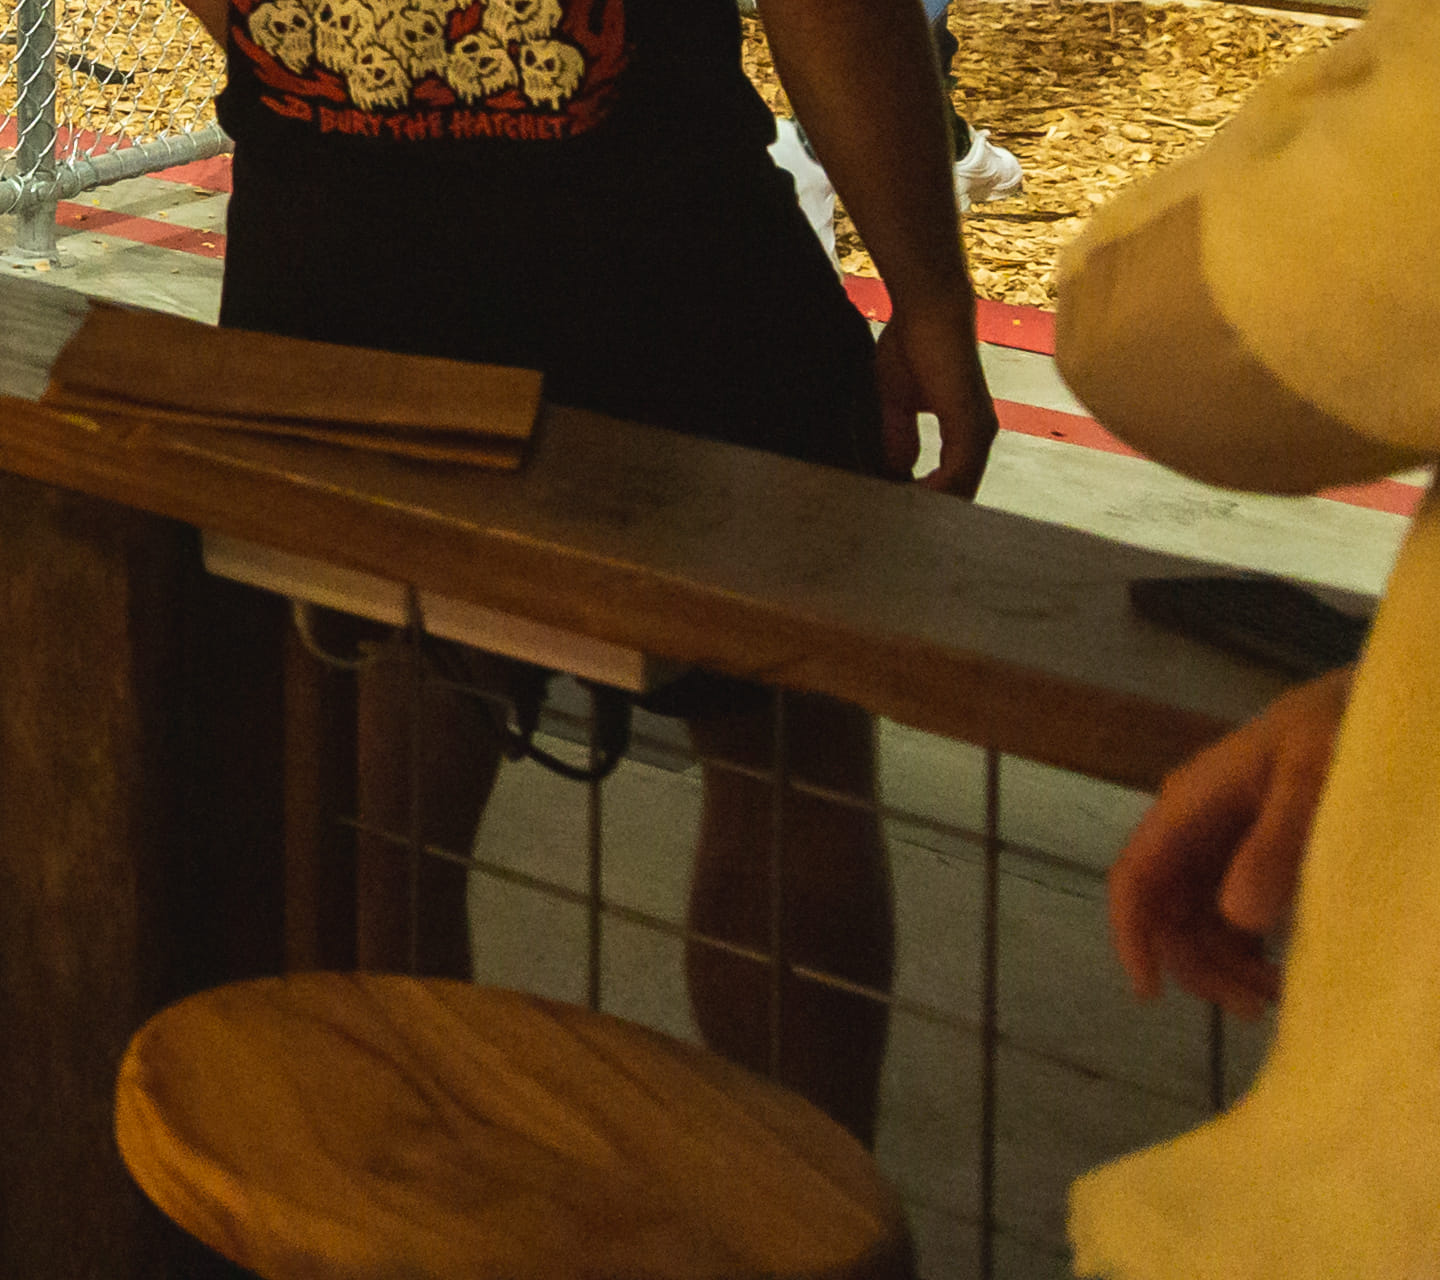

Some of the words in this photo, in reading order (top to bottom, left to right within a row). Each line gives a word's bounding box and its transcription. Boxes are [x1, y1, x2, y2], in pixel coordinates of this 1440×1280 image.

[318, 106, 382, 137] BURY
[385, 110, 444, 140] THE
[449, 109, 567, 139] HATCHET
